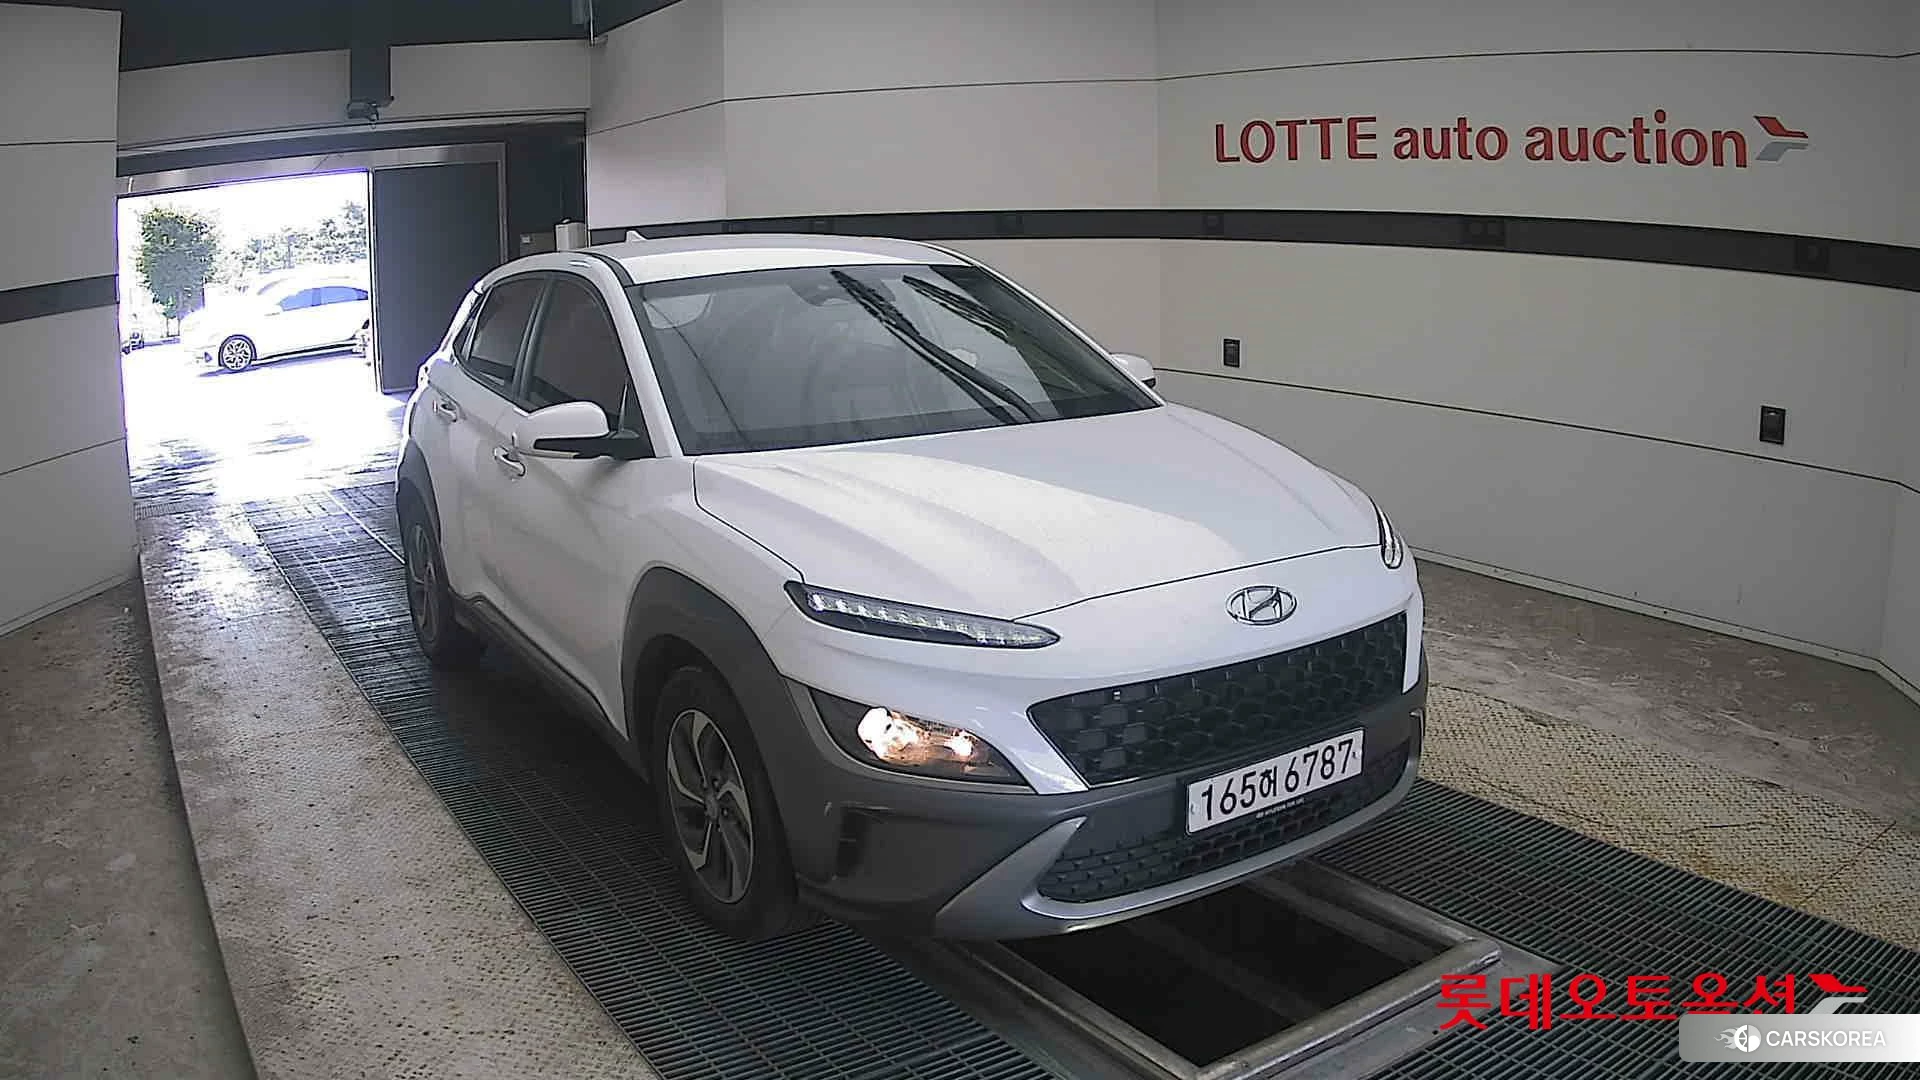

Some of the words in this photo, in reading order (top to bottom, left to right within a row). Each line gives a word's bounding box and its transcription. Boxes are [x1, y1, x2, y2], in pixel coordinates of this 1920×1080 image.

[1214, 115, 1378, 164] LOTTE
[1392, 116, 1509, 161] auto
[1524, 109, 1748, 168] auction
